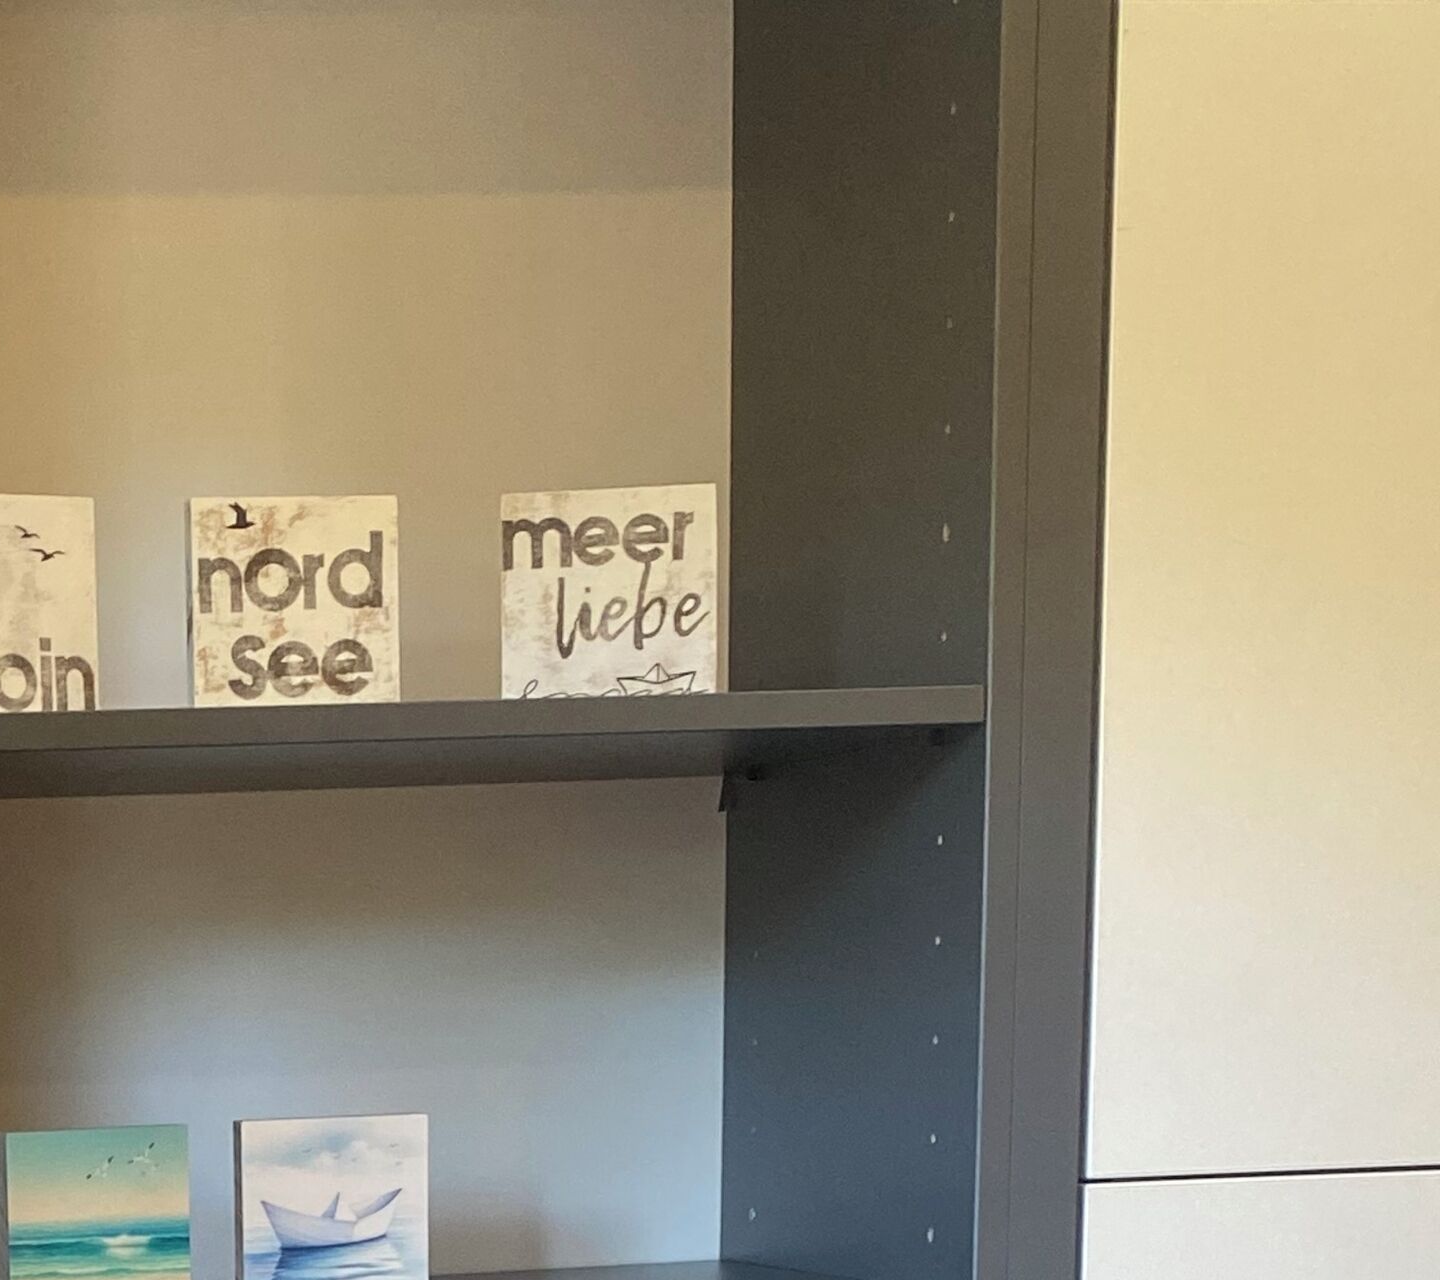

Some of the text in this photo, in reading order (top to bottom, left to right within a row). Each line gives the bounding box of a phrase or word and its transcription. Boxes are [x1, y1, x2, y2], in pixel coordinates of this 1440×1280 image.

[198, 531, 383, 614] nord
[502, 511, 694, 571] meer
[557, 561, 710, 659] liebe
[228, 635, 373, 699] see
